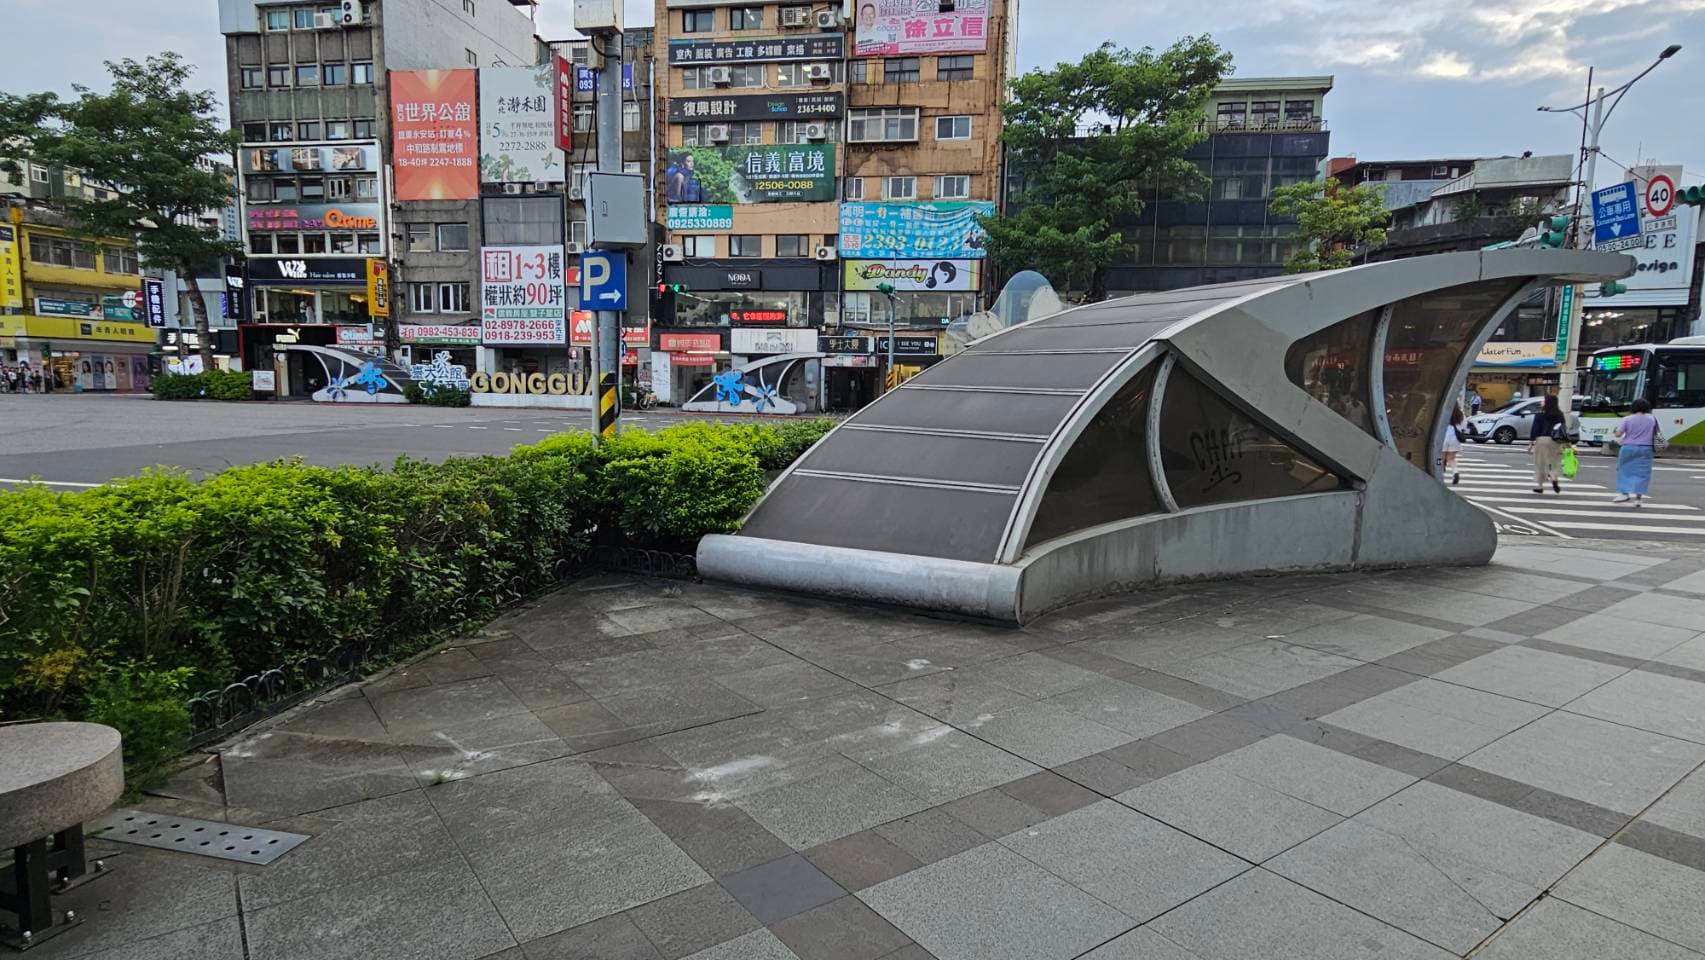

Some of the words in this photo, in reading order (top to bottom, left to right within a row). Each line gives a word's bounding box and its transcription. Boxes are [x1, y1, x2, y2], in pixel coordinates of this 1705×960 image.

[904, 17, 984, 39] 徐立信
[716, 47, 733, 58] 廣告
[684, 100, 736, 116] 復興設計
[797, 104, 836, 113] 2365-4400
[499, 142, 547, 151] 2272-2888
[430, 158, 472, 167] 2247-1888
[745, 151, 781, 174] 信義
[788, 150, 825, 173] 富境
[759, 181, 814, 190] 2506-0088
[1651, 188, 1669, 203] 40
[1599, 201, 1631, 218] 公車專用
[484, 251, 512, 282] 租
[867, 264, 928, 283] Dandy
[1637, 260, 1678, 273] esign
[583, 256, 611, 301] P
[485, 283, 562, 306] 權狀約90坪
[417, 327, 479, 337] 0982-453-836
[485, 320, 555, 330] 02-8978-2666
[485, 331, 555, 340] 0918-239-953
